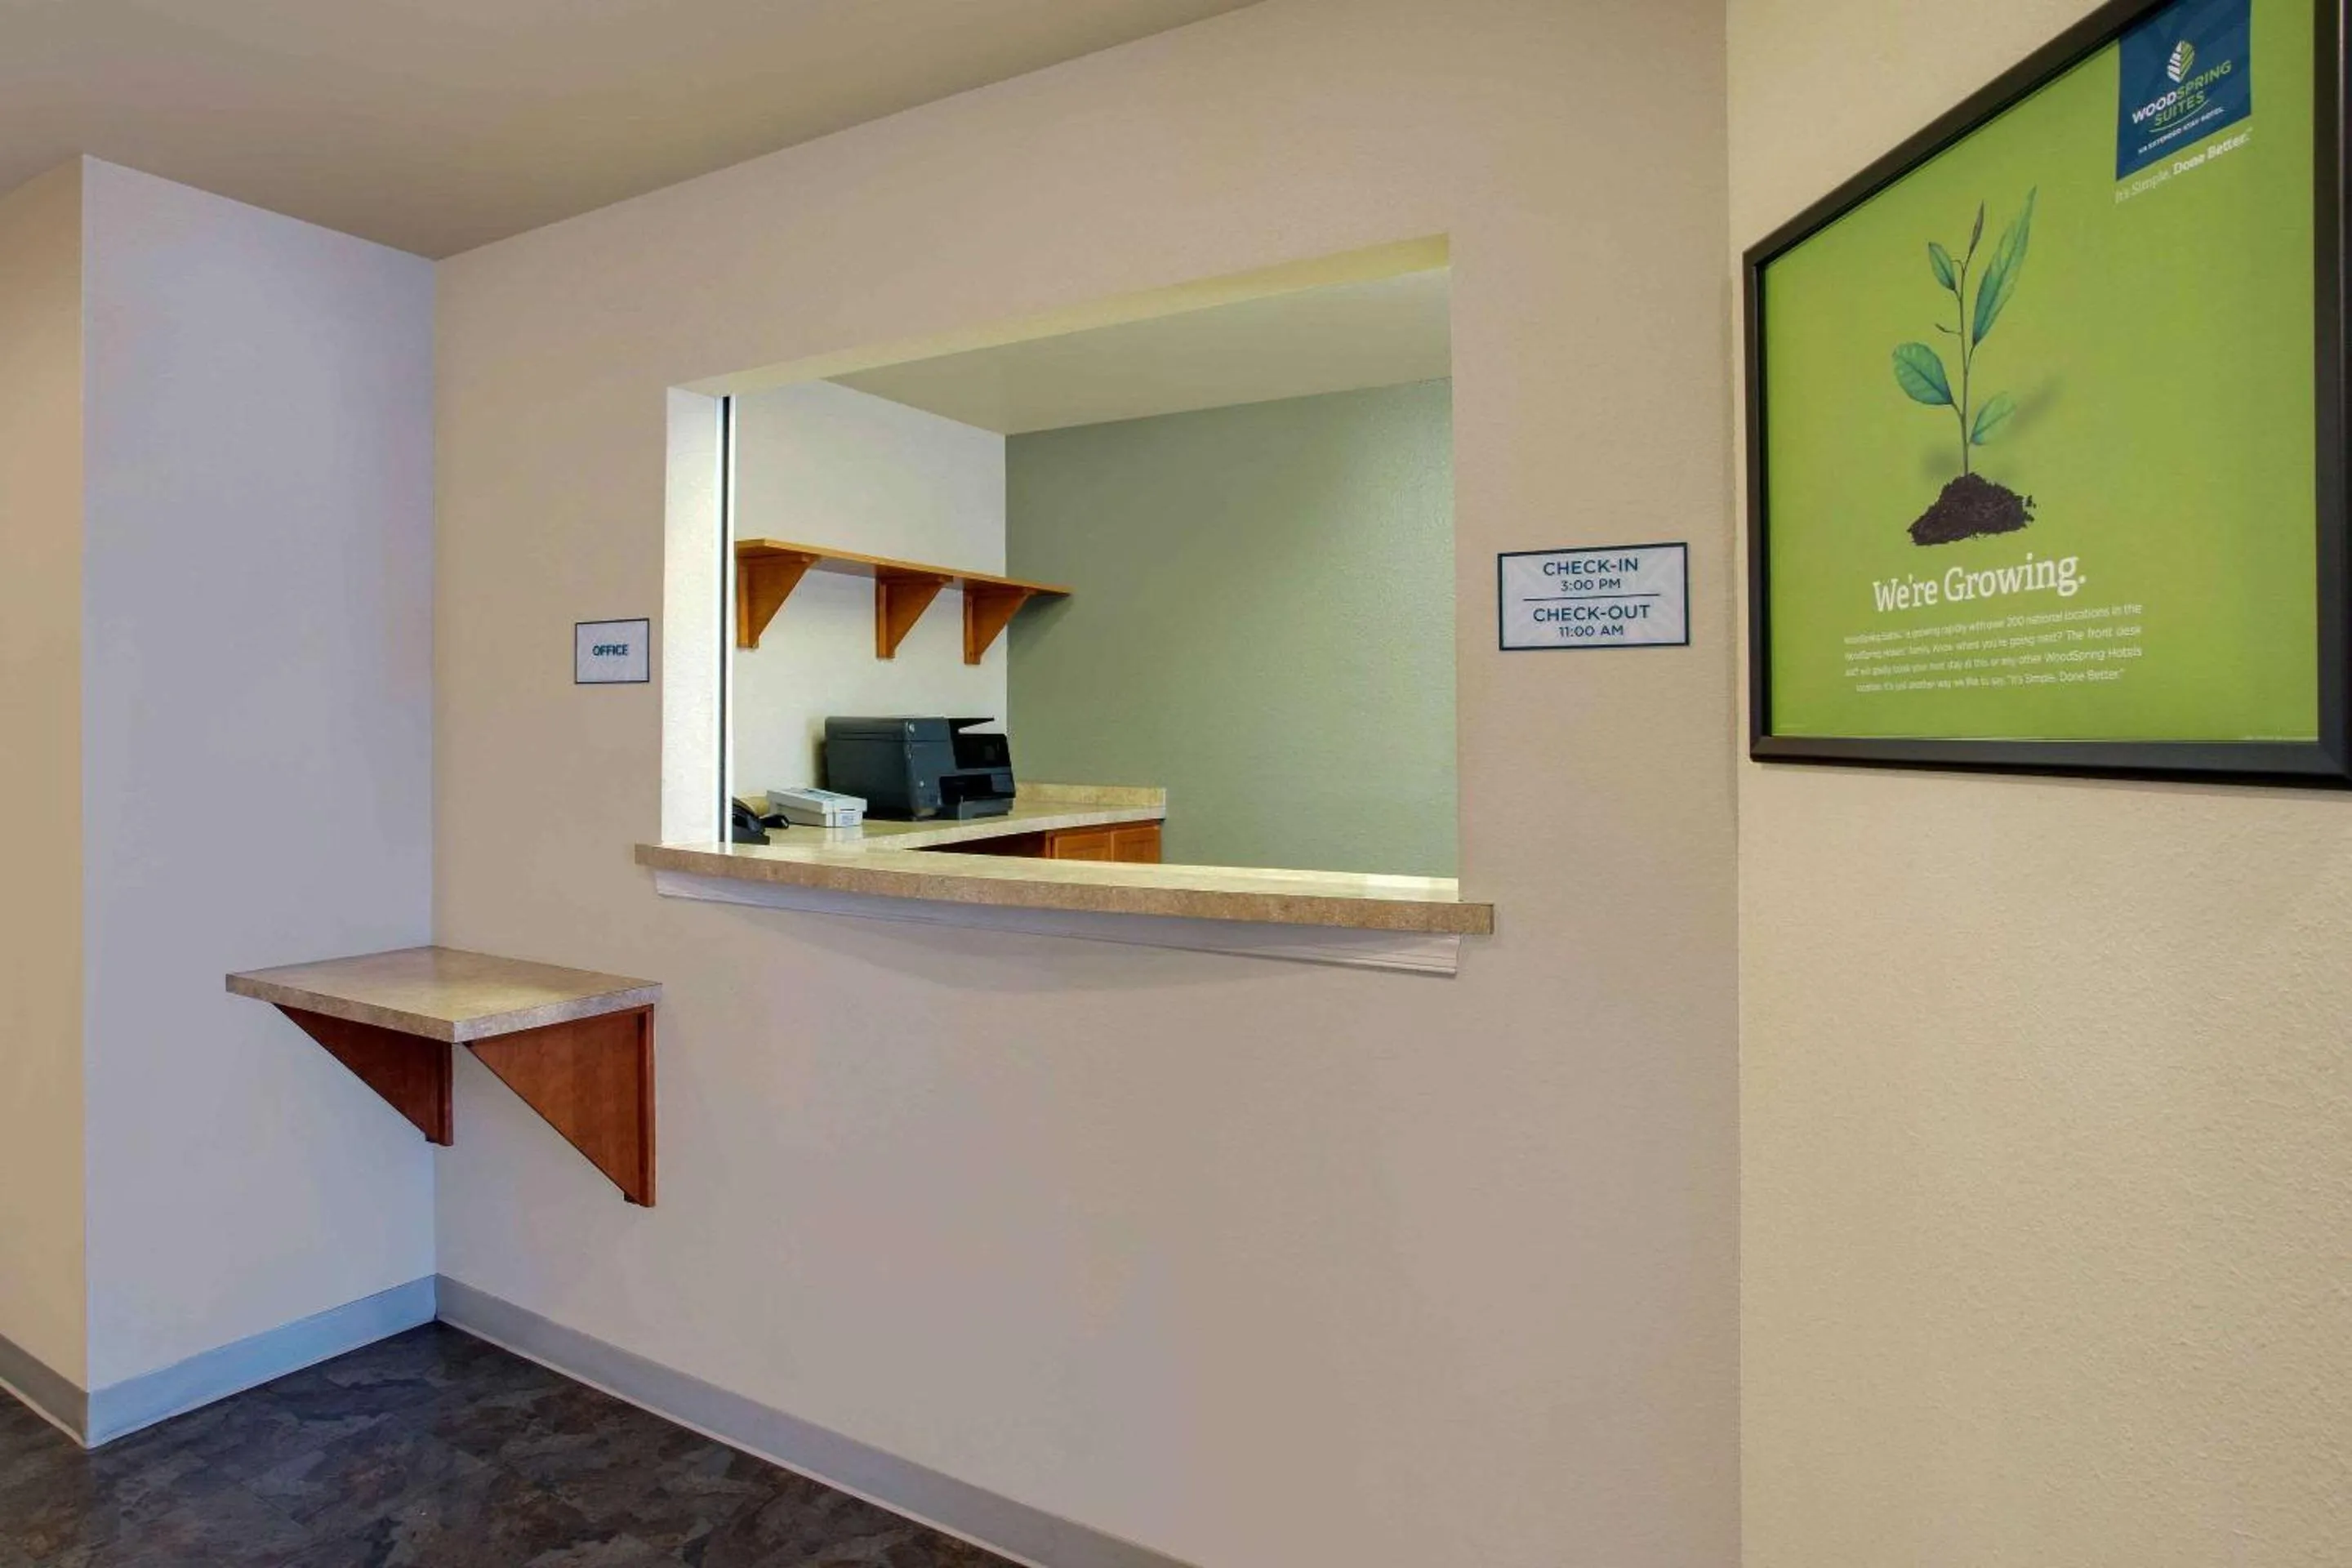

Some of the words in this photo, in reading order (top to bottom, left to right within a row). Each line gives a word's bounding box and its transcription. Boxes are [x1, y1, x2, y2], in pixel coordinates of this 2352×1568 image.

[2132, 60, 2231, 124] WOODSPRING
[2154, 90, 2204, 126] SUITES
[2172, 154, 2205, 175] Done
[1543, 557, 1638, 577] CHECK-IN
[1561, 579, 1594, 591] 3:00
[1598, 578, 1621, 590] PM
[1873, 574, 1938, 612] We're
[1944, 552, 2086, 601] Growing.
[1533, 604, 1650, 622] CHECK-OUT
[2007, 614, 2025, 627] 200
[1559, 626, 1595, 637] 11:00
[1601, 625, 1624, 636] AM
[2065, 629, 2085, 641] The
[592, 644, 628, 656] OFFICE
